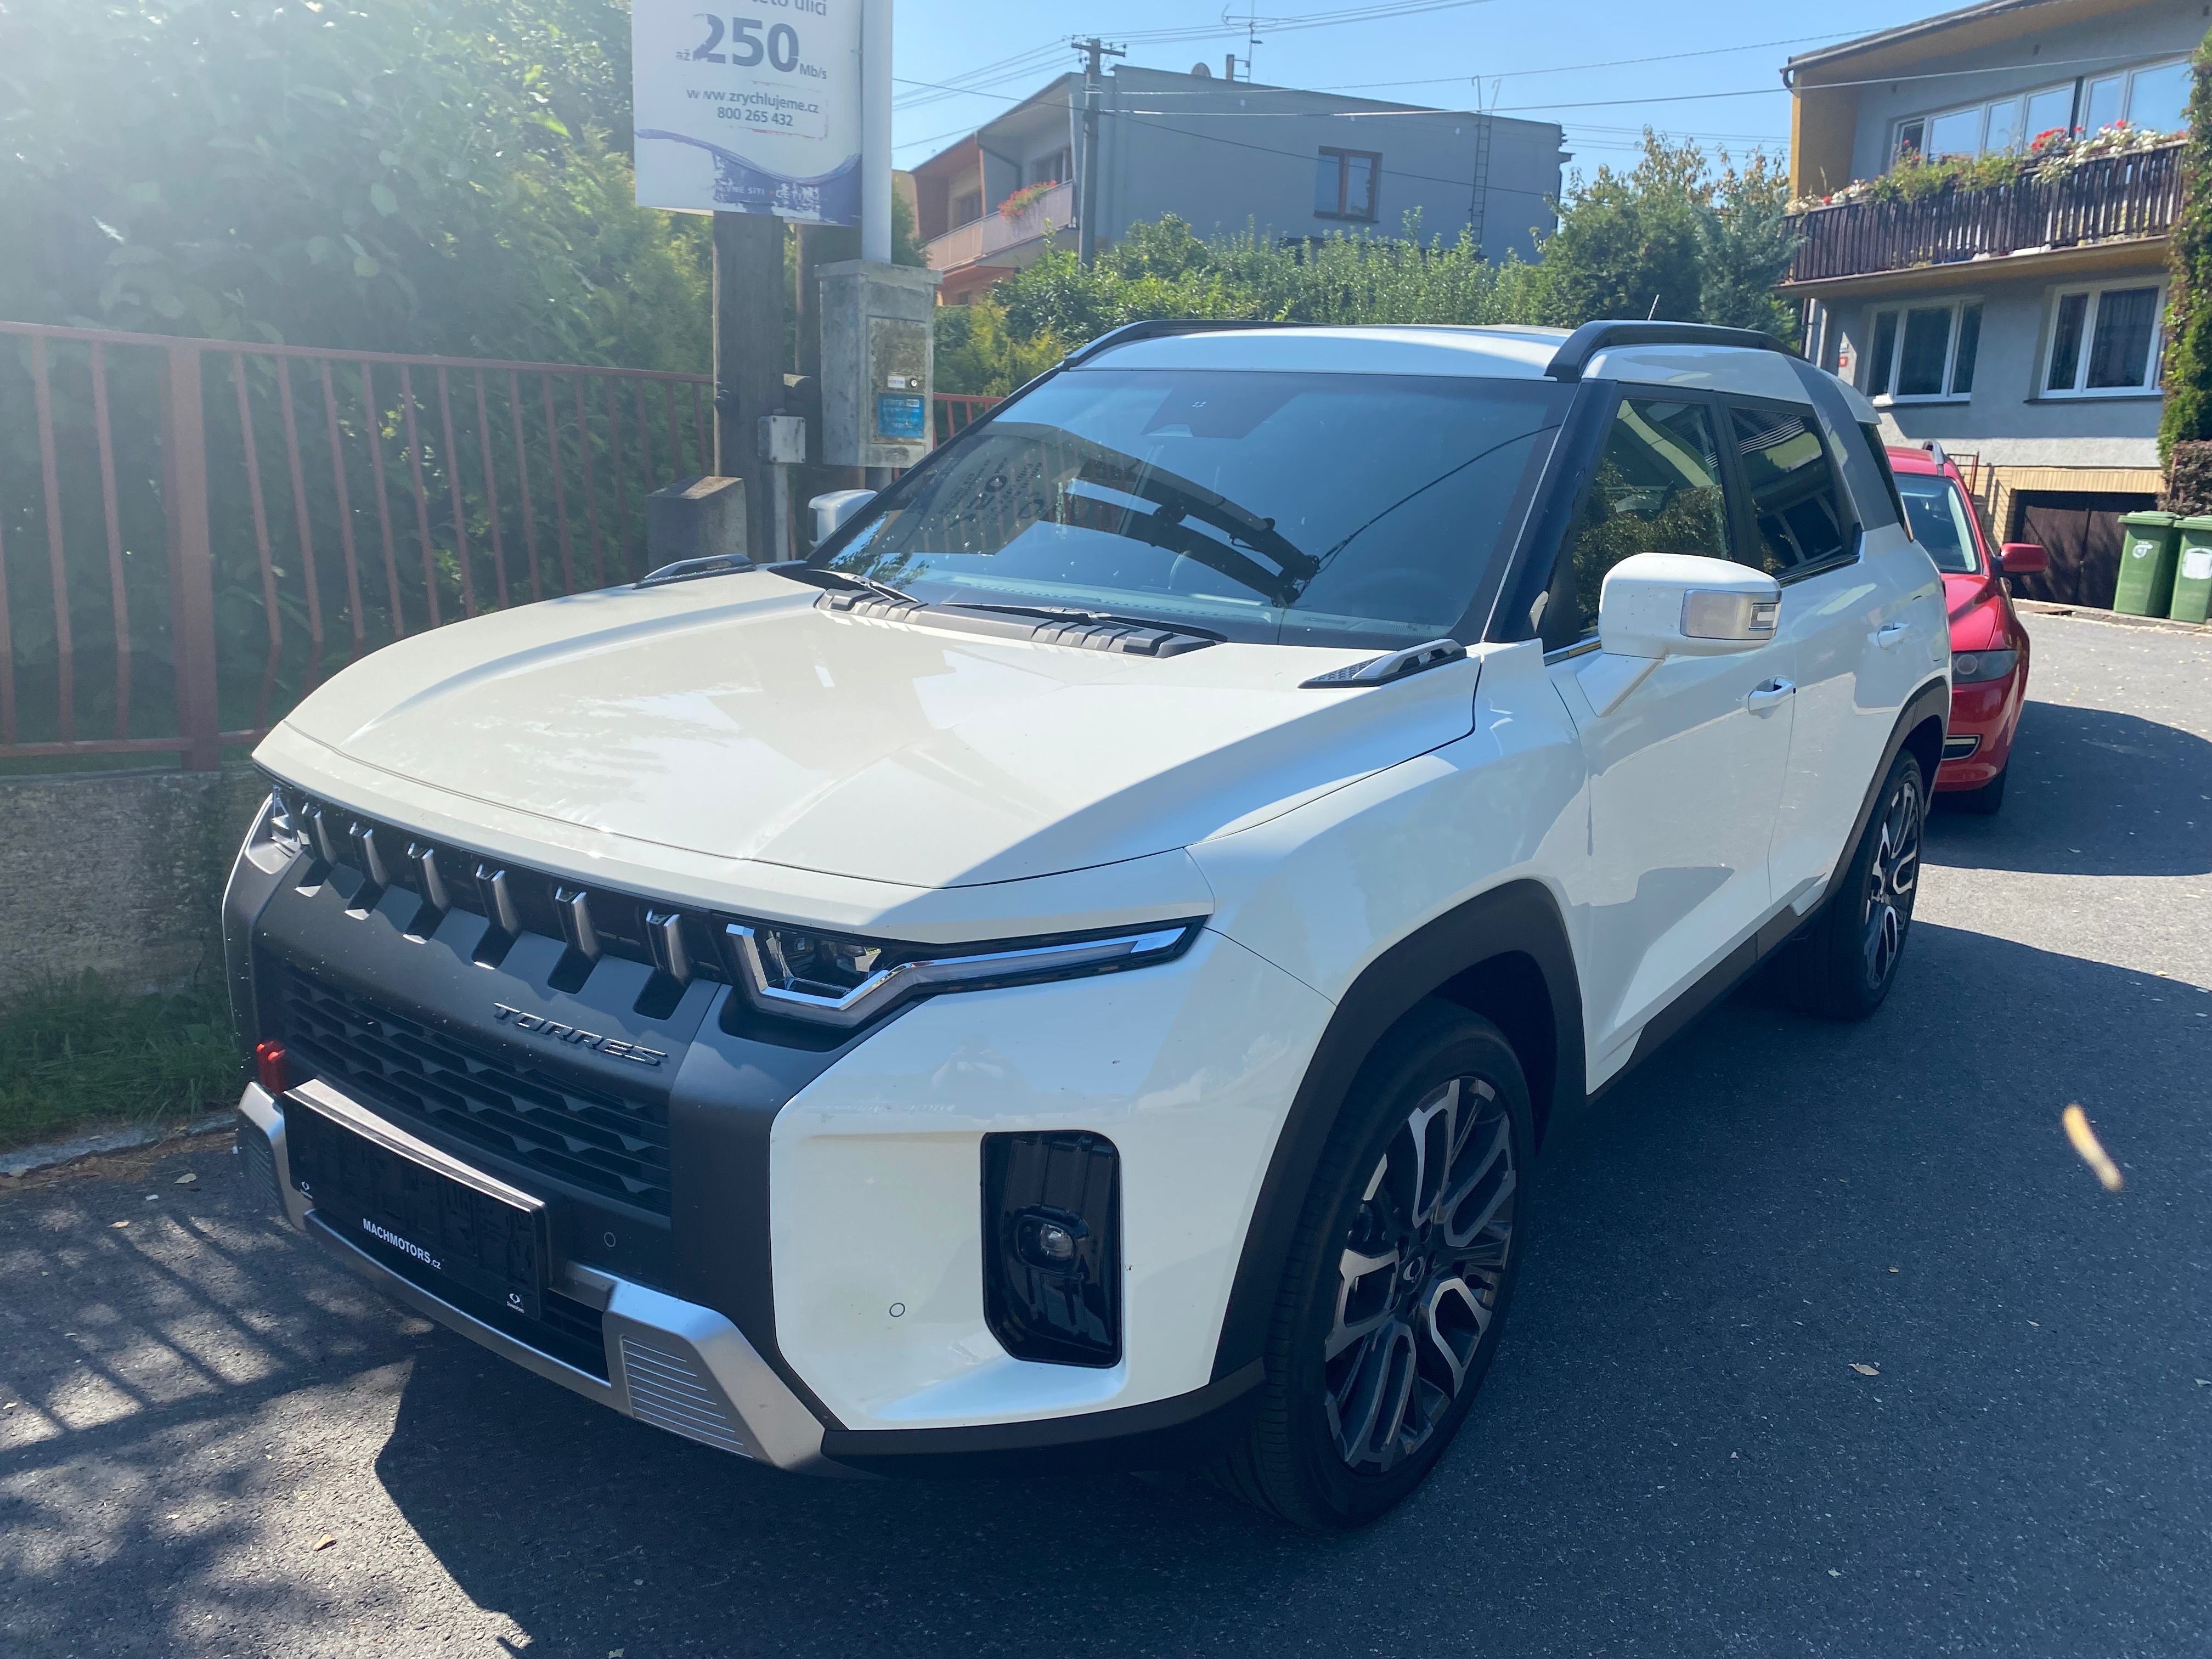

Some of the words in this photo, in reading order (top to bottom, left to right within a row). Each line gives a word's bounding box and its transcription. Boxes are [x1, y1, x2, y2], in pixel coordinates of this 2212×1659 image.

[693, 13, 799, 72] 250
[799, 63, 827, 80] Mb/s
[717, 107, 741, 120] 800
[745, 109, 768, 123] 265
[771, 112, 793, 126] 432
[494, 1002, 668, 1066] TORRES
